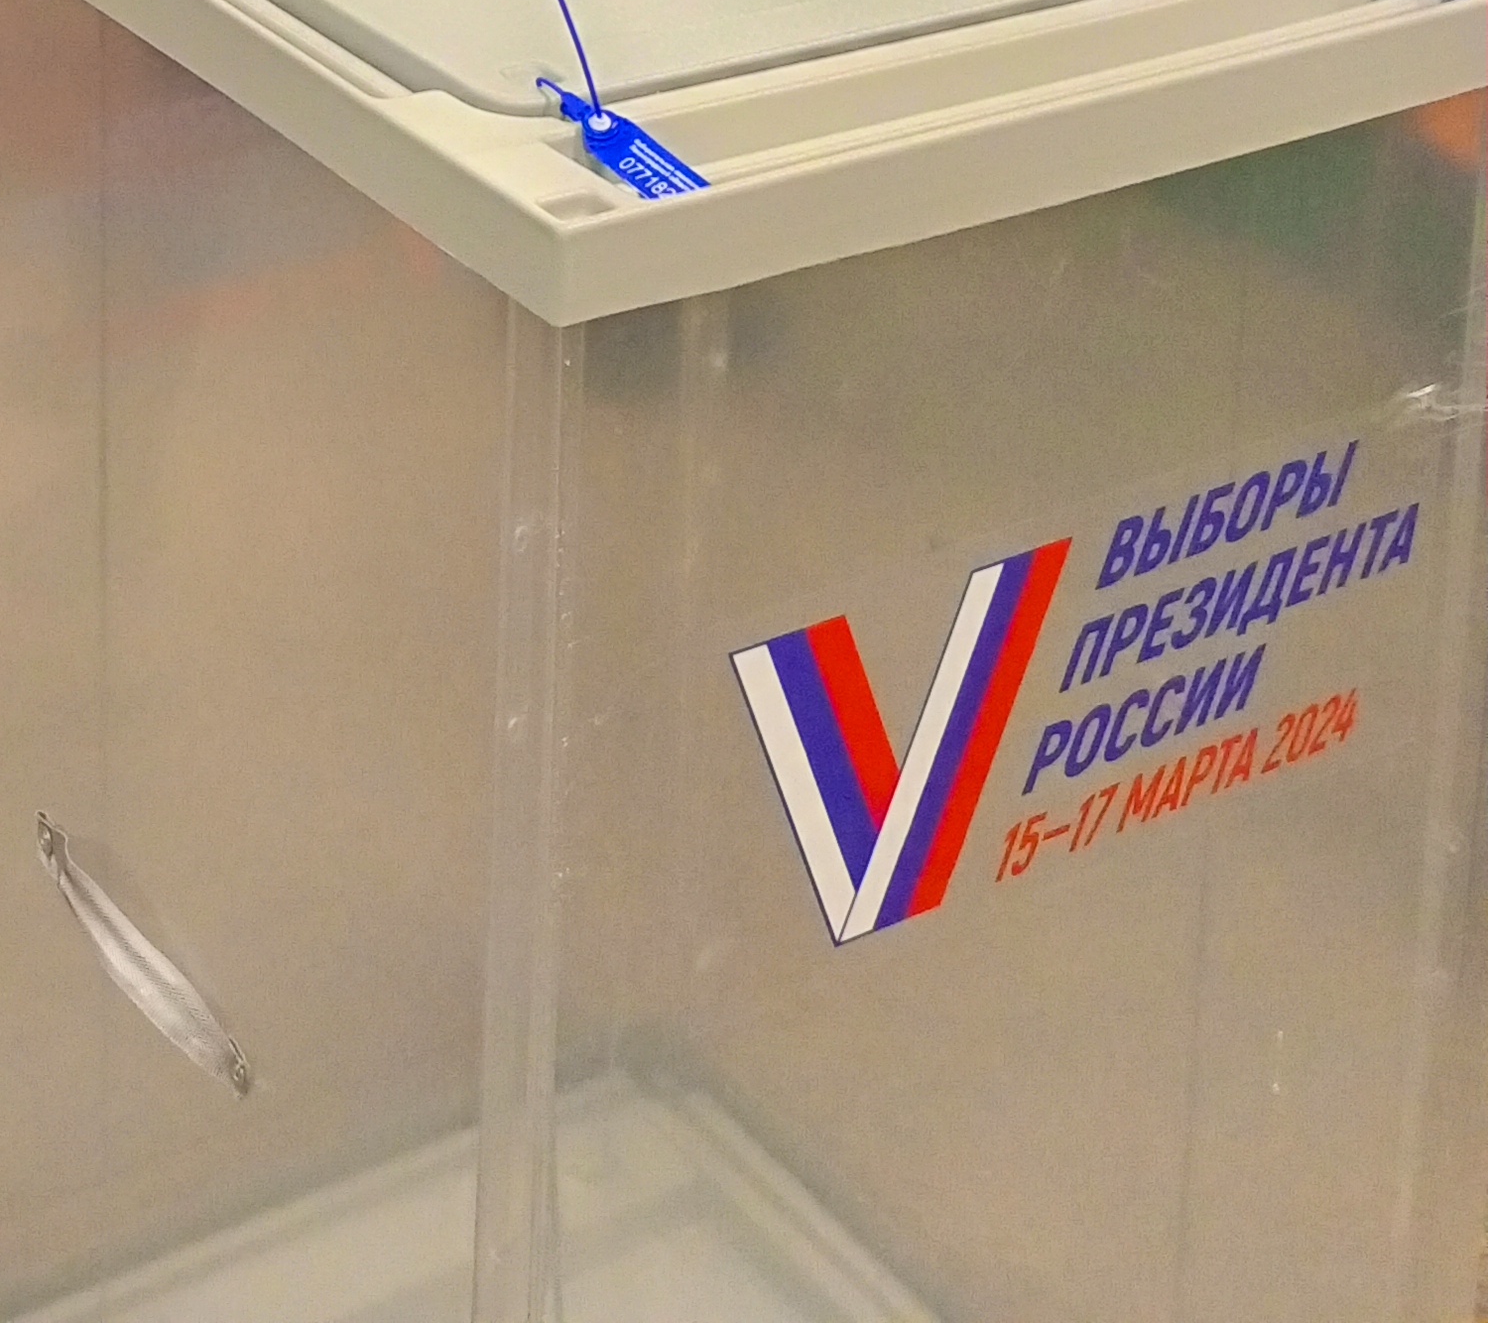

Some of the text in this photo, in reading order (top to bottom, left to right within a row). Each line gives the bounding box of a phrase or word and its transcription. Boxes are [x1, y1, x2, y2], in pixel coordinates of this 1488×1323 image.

[1095, 439, 1360, 591] ВЫБОРЫ
[1058, 502, 1420, 694] ПРЕЗИДЕНТА
[1021, 644, 1266, 797] РОССИИ
[1116, 726, 1259, 835] МАРТА
[1259, 687, 1359, 777] 2024
